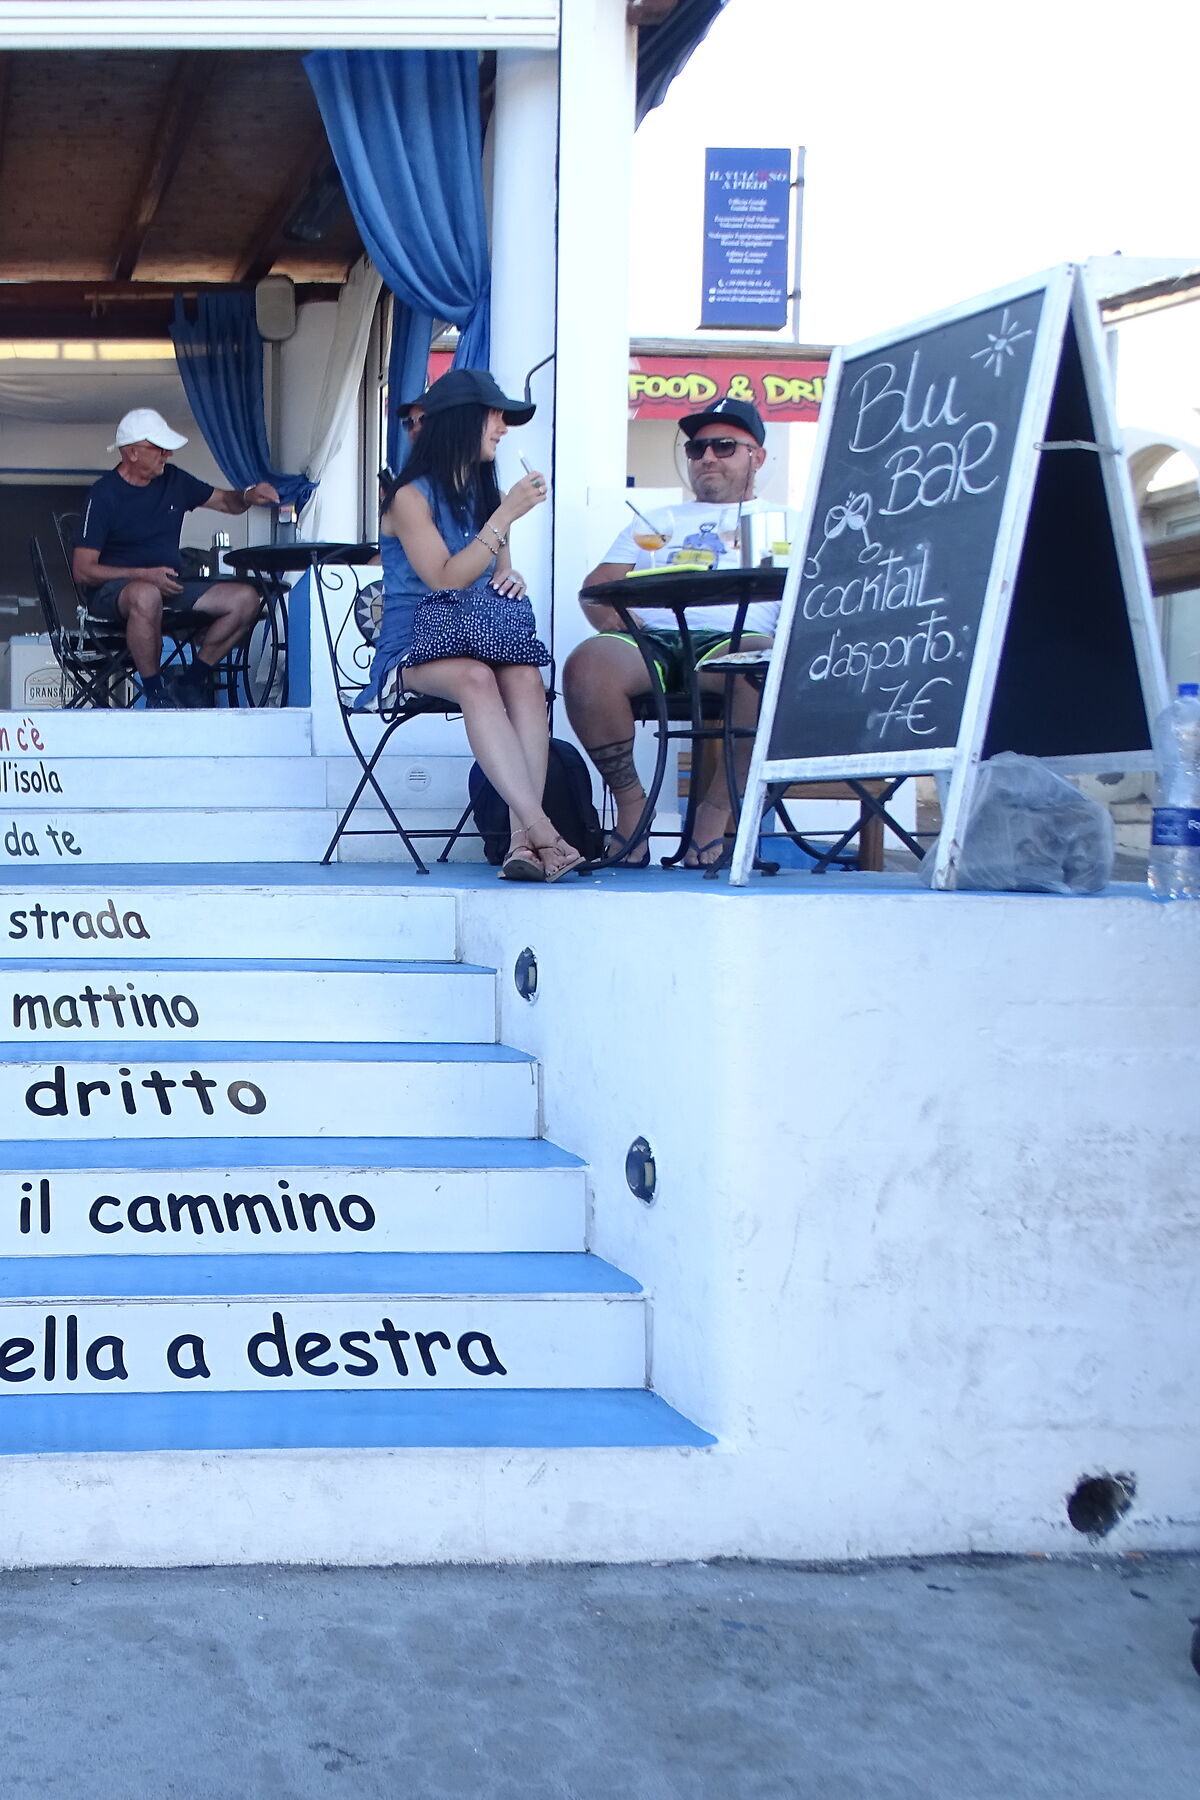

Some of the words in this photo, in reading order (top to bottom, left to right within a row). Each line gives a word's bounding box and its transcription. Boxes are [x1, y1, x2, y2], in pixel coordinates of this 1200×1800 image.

[628, 373, 717, 404] FOOD
[726, 375, 754, 402] &
[762, 374, 827, 405] DRI
[848, 349, 967, 453] Blu
[876, 676, 953, 739] 7€
[17, 717, 45, 751] c'è
[4, 821, 40, 857] da
[45, 824, 82, 857] te
[8, 898, 151, 940] strada
[12, 982, 199, 1031] mattino
[25, 1065, 267, 1117] dritto
[19, 1178, 51, 1235] il
[88, 1179, 376, 1236] cammino
[166, 1333, 211, 1380] a
[246, 1311, 508, 1378] destra
